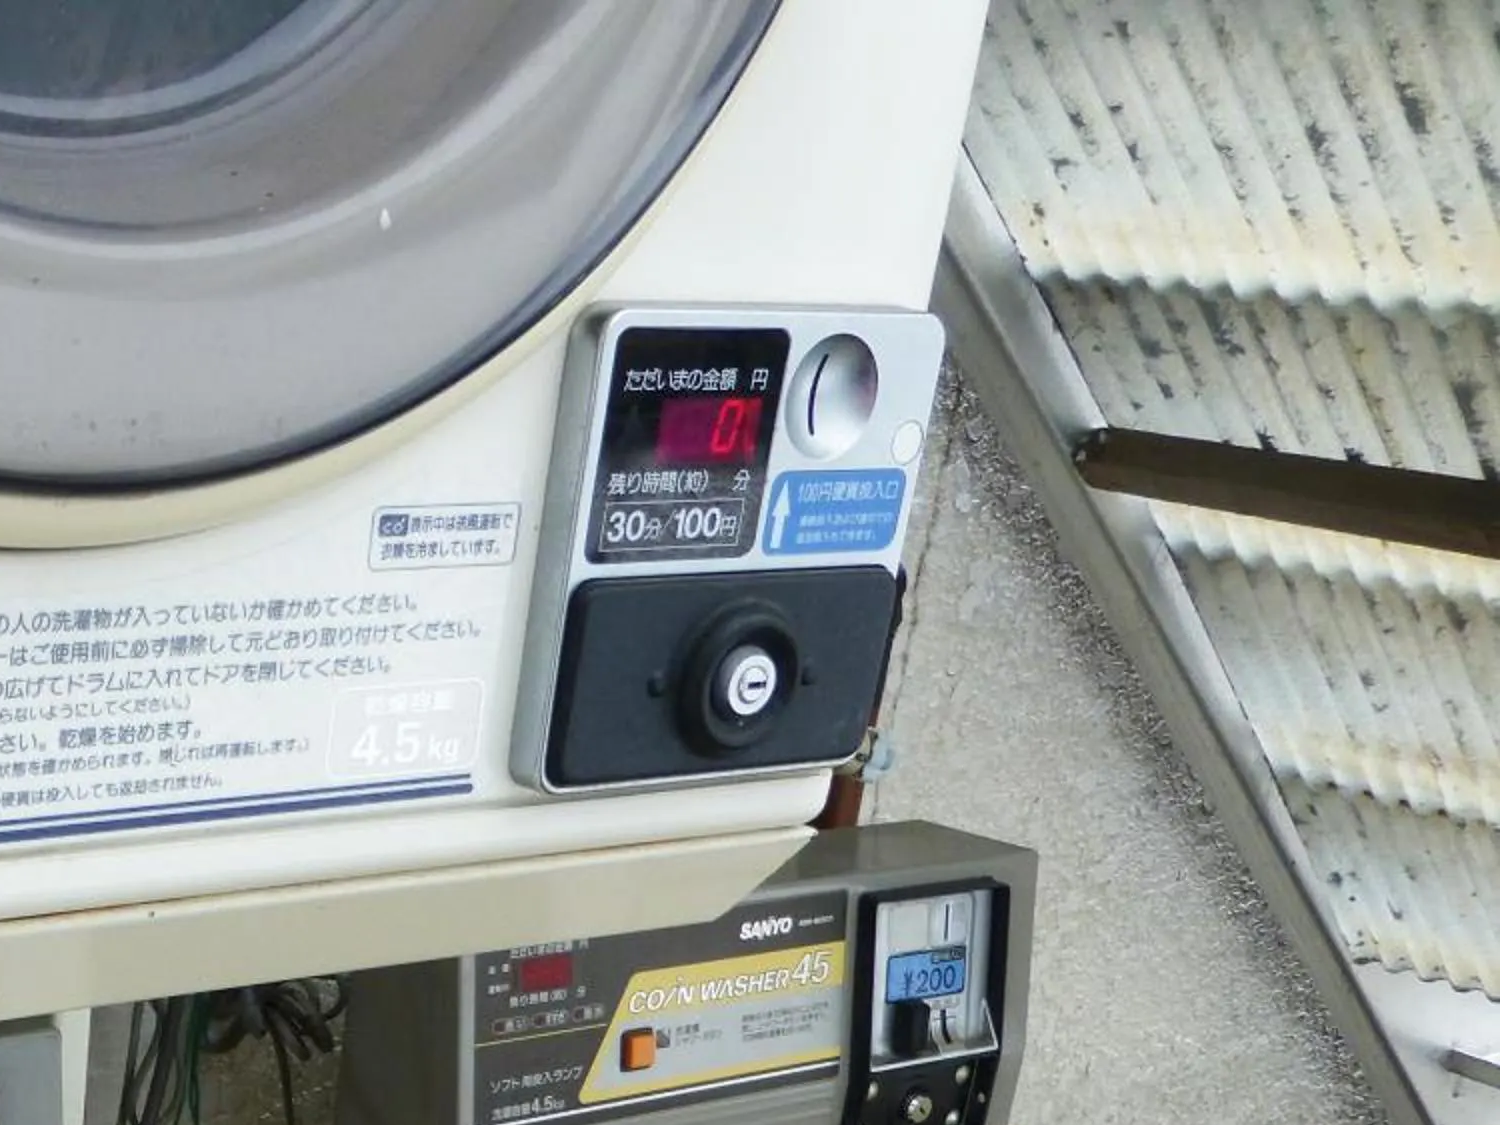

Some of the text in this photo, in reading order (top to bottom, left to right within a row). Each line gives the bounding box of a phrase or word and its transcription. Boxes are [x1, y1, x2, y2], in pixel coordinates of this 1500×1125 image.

[623, 367, 770, 393] ただいまの金額 円
[731, 468, 752, 493] 分
[739, 915, 794, 941] SANYO
[700, 967, 790, 1002] WASHER
[790, 950, 833, 987] 45
